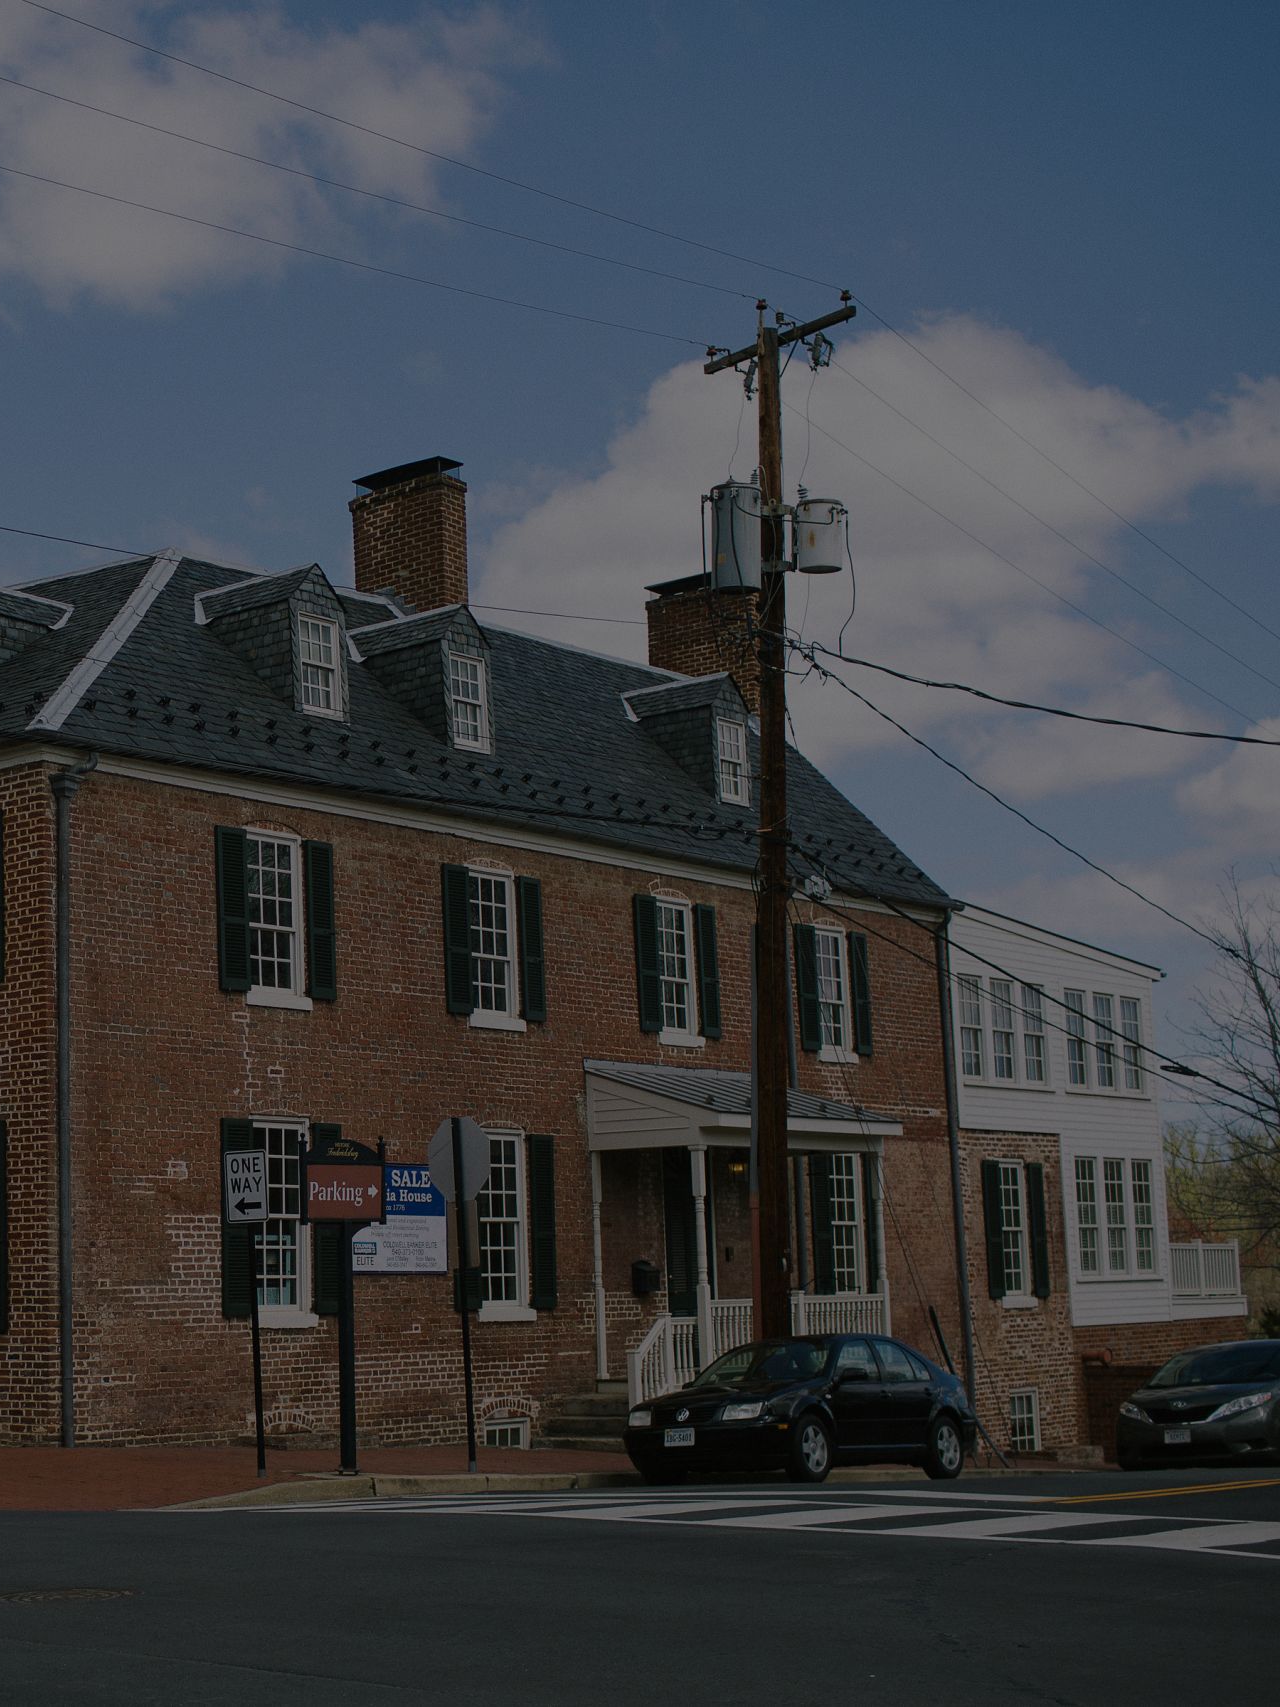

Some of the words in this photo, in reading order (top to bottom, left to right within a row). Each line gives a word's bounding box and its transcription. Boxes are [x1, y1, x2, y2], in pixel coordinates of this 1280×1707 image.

[230, 1157, 261, 1174] ONE
[231, 1176, 262, 1194] WAY
[391, 1169, 431, 1187] SALE
[309, 1181, 363, 1206] Parking
[399, 1190, 432, 1202] House
[356, 1257, 374, 1265] ELITE
